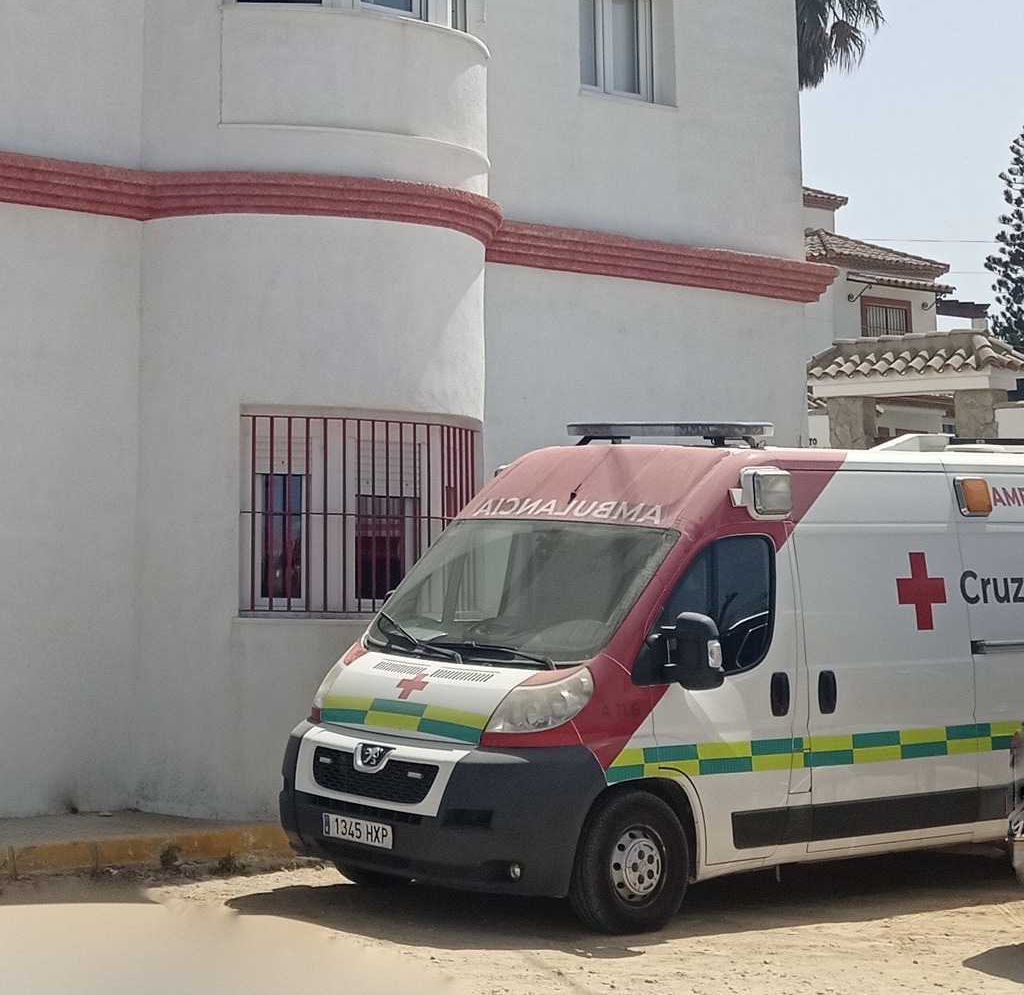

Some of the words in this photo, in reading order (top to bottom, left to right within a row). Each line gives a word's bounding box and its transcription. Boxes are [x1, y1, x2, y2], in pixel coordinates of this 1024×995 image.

[960, 570, 1024, 605] Cruz
[335, 818, 362, 839] 1345
[366, 824, 388, 844] HXP
